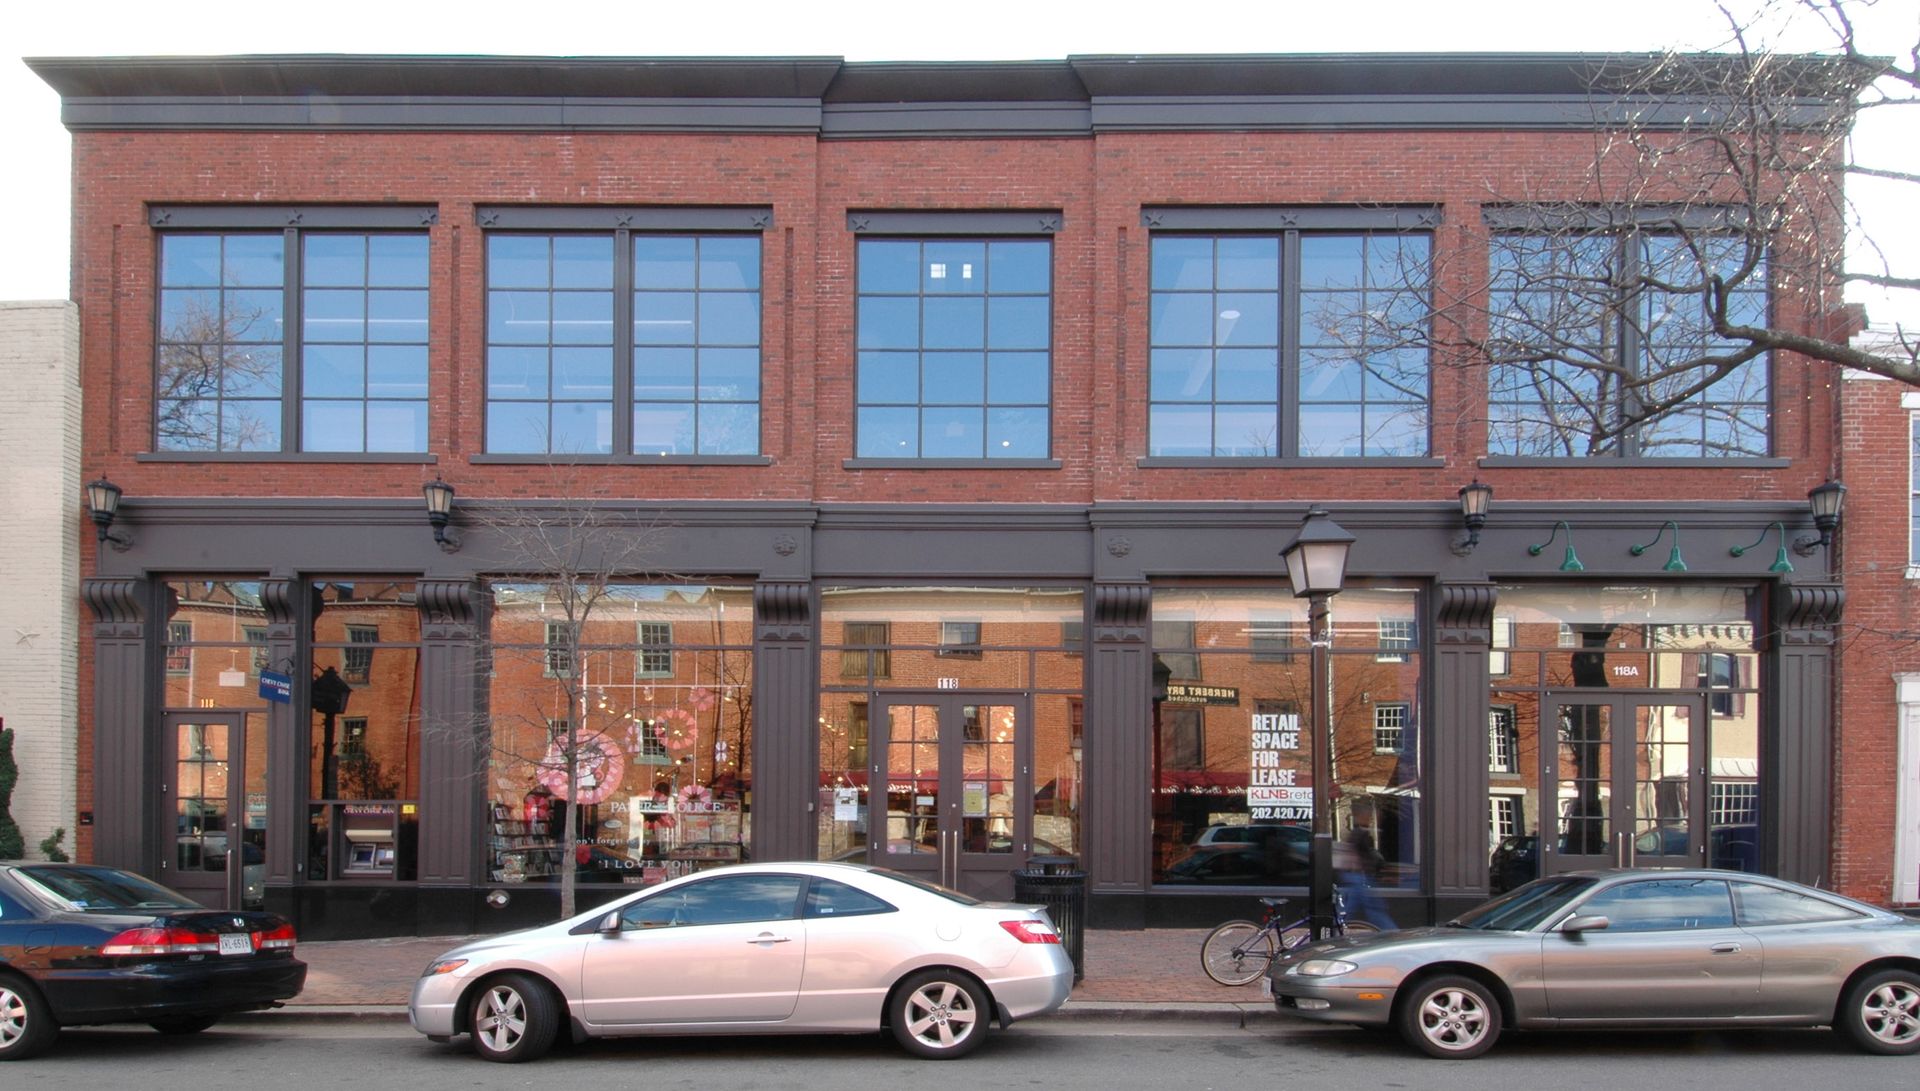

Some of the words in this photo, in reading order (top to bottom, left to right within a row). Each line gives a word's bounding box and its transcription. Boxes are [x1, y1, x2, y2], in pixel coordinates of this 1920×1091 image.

[1613, 666, 1639, 676] 118A
[937, 677, 959, 689] 118
[201, 699, 214, 708] 118
[1251, 714, 1301, 731] RETAIL
[1251, 732, 1299, 749] SPACE
[1251, 751, 1279, 767] FOR
[1251, 769, 1296, 786] LEASE
[611, 802, 653, 812] PAER
[670, 802, 721, 812] OURCE
[575, 837, 594, 845] on't
[615, 860, 655, 869] LOVE
